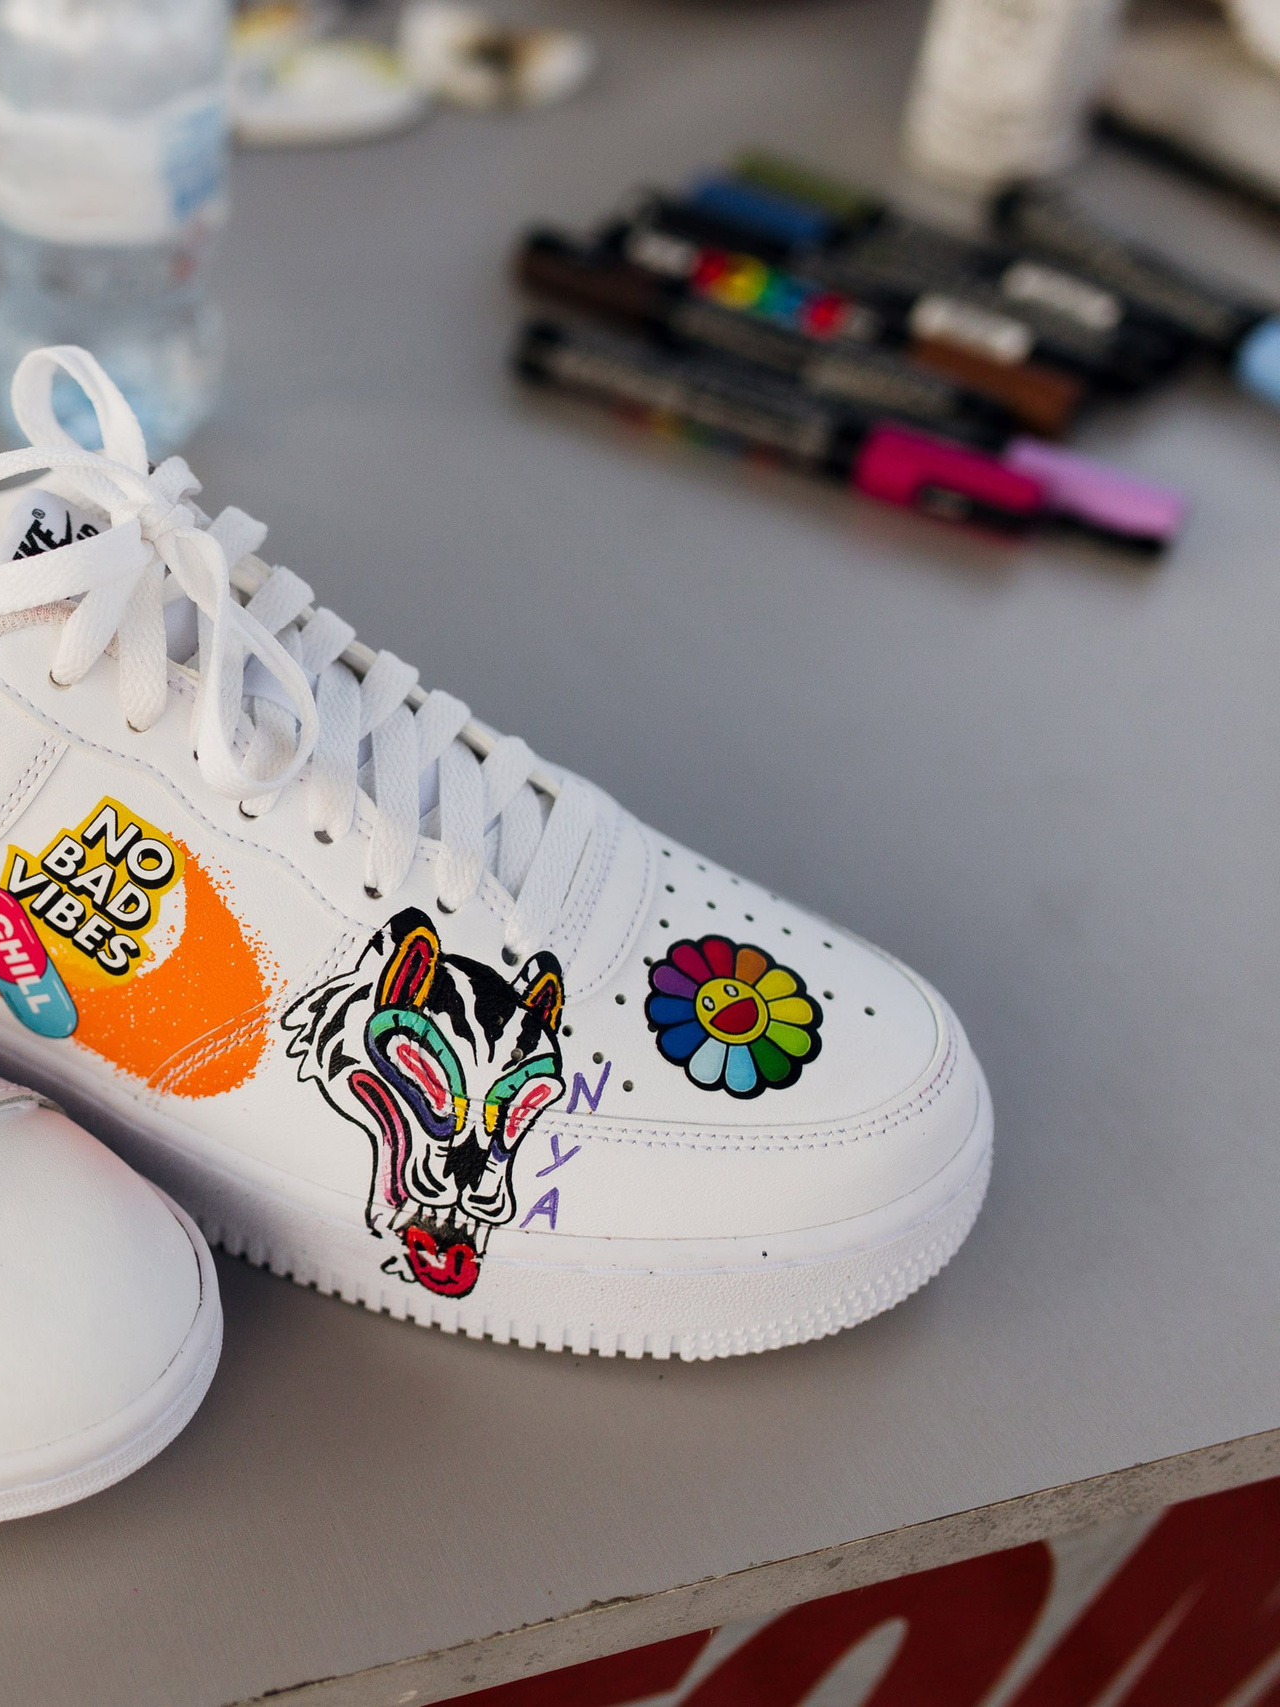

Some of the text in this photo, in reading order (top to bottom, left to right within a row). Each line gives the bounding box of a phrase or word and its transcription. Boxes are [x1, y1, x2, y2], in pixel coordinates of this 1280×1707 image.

[41, 834, 151, 931] BAD
[81, 804, 175, 889] NO
[8, 853, 141, 976] VIBES
